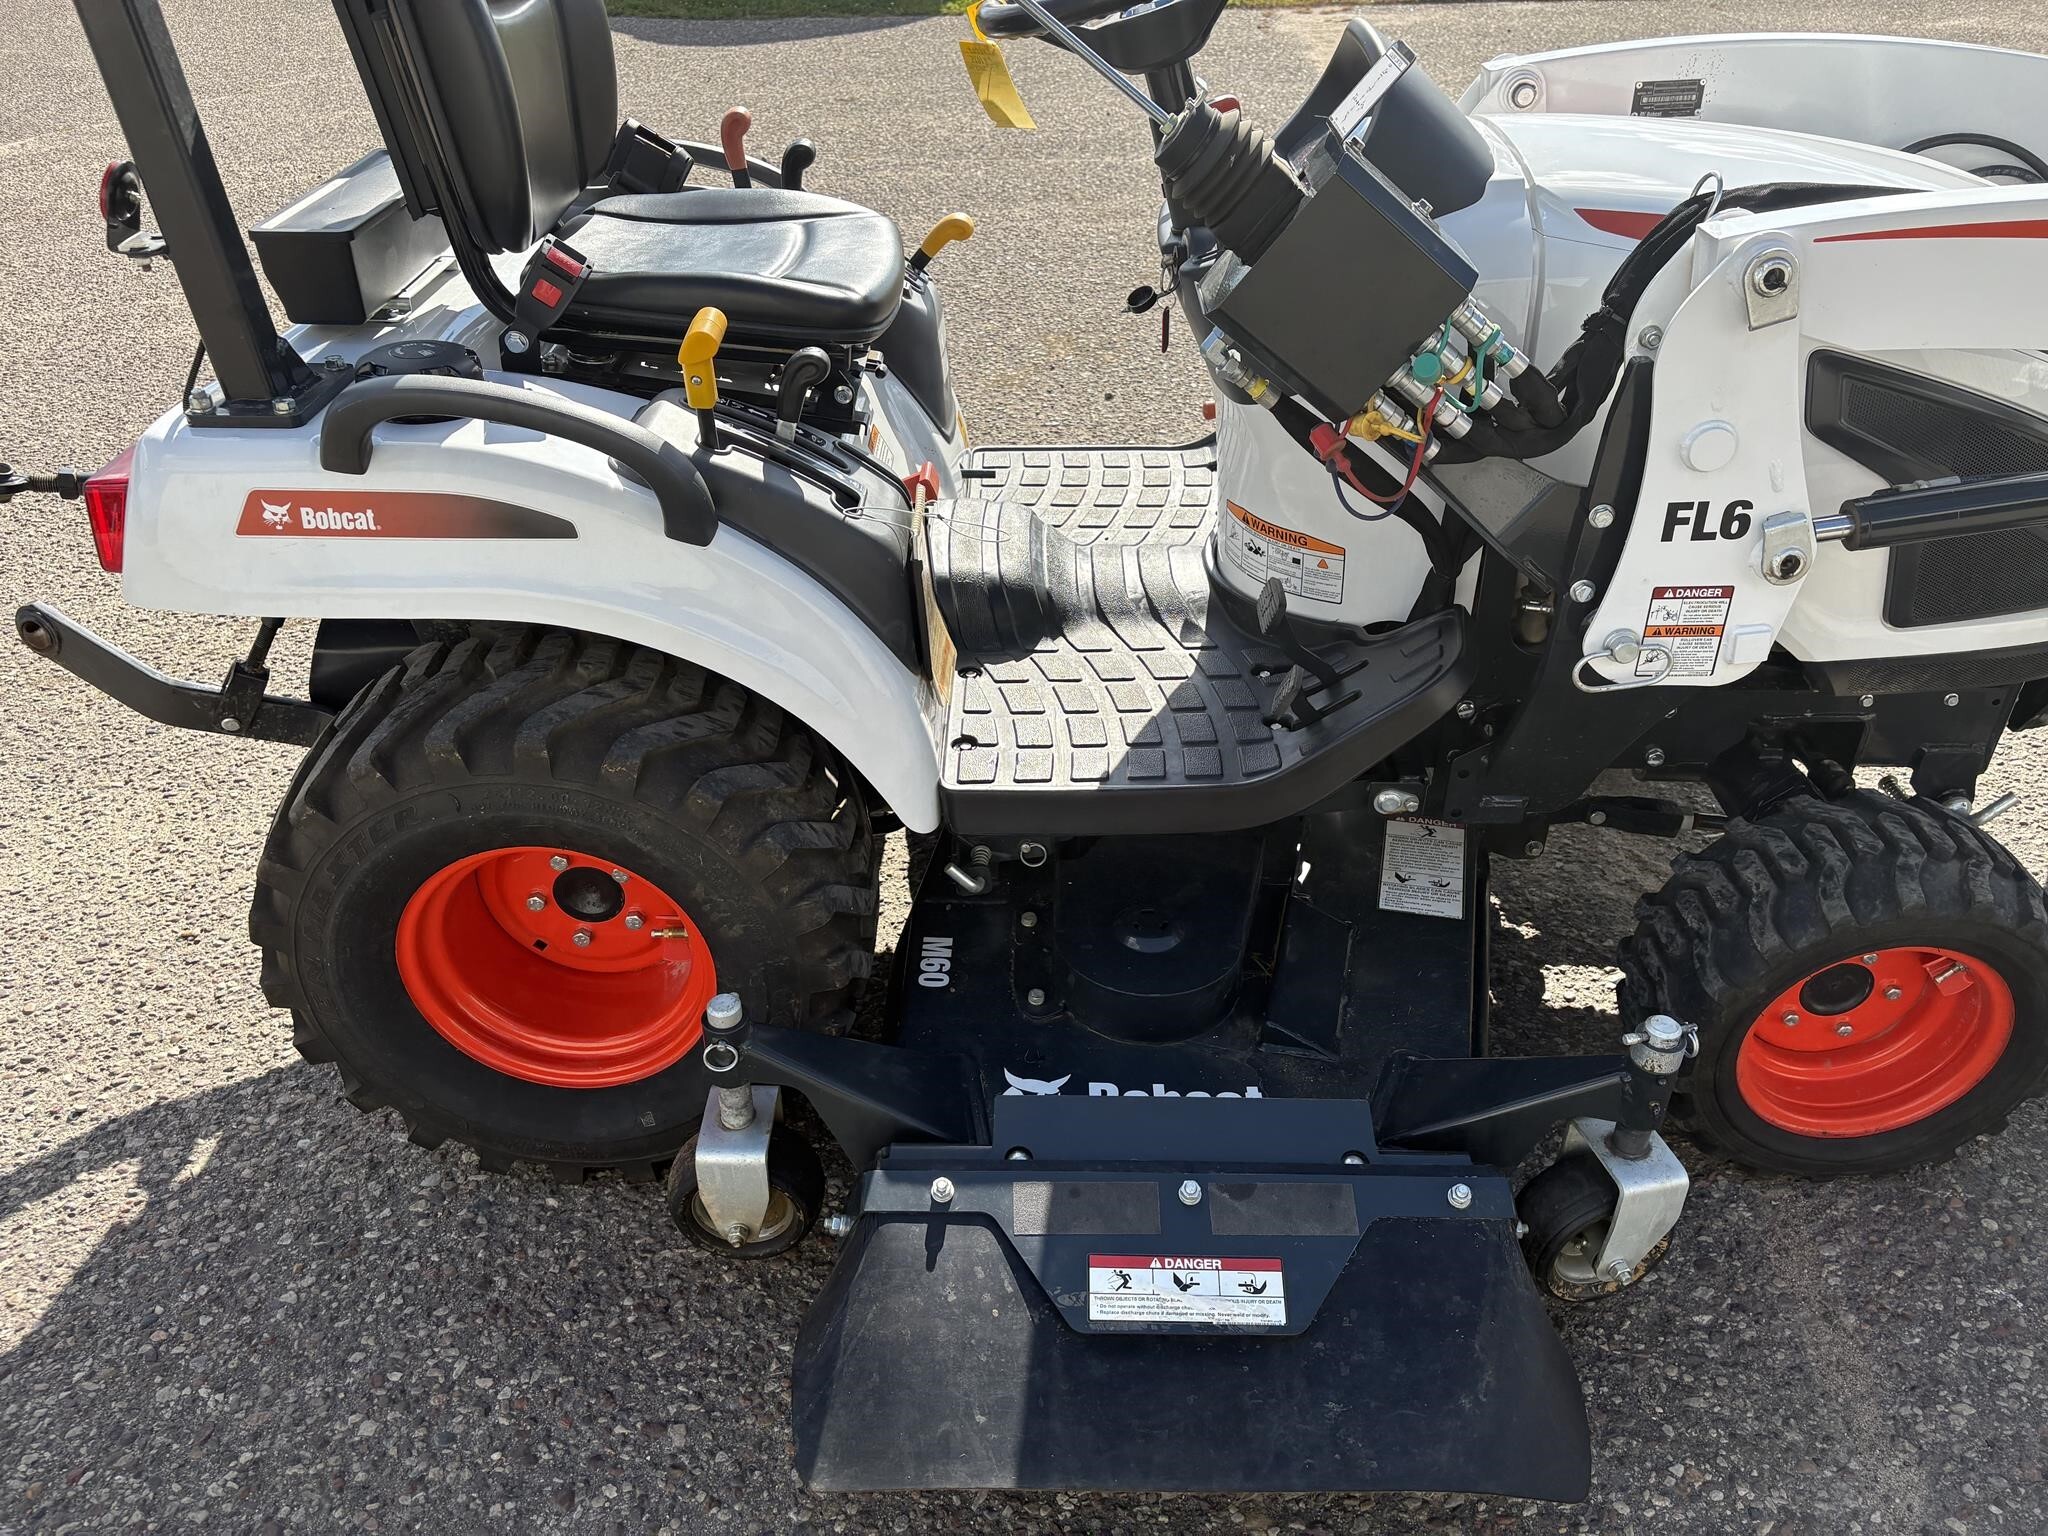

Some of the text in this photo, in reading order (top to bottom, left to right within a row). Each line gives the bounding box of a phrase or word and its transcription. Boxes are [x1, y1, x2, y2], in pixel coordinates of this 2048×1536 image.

[300, 507, 377, 530] Bobcat
[1660, 500, 1754, 542] FL6
[1250, 518, 1308, 547] WARNING
[1675, 588, 1722, 598] DANGER
[1664, 626, 1716, 636] WARNING
[918, 936, 953, 988] M60
[1164, 1258, 1222, 1270] DANGER
